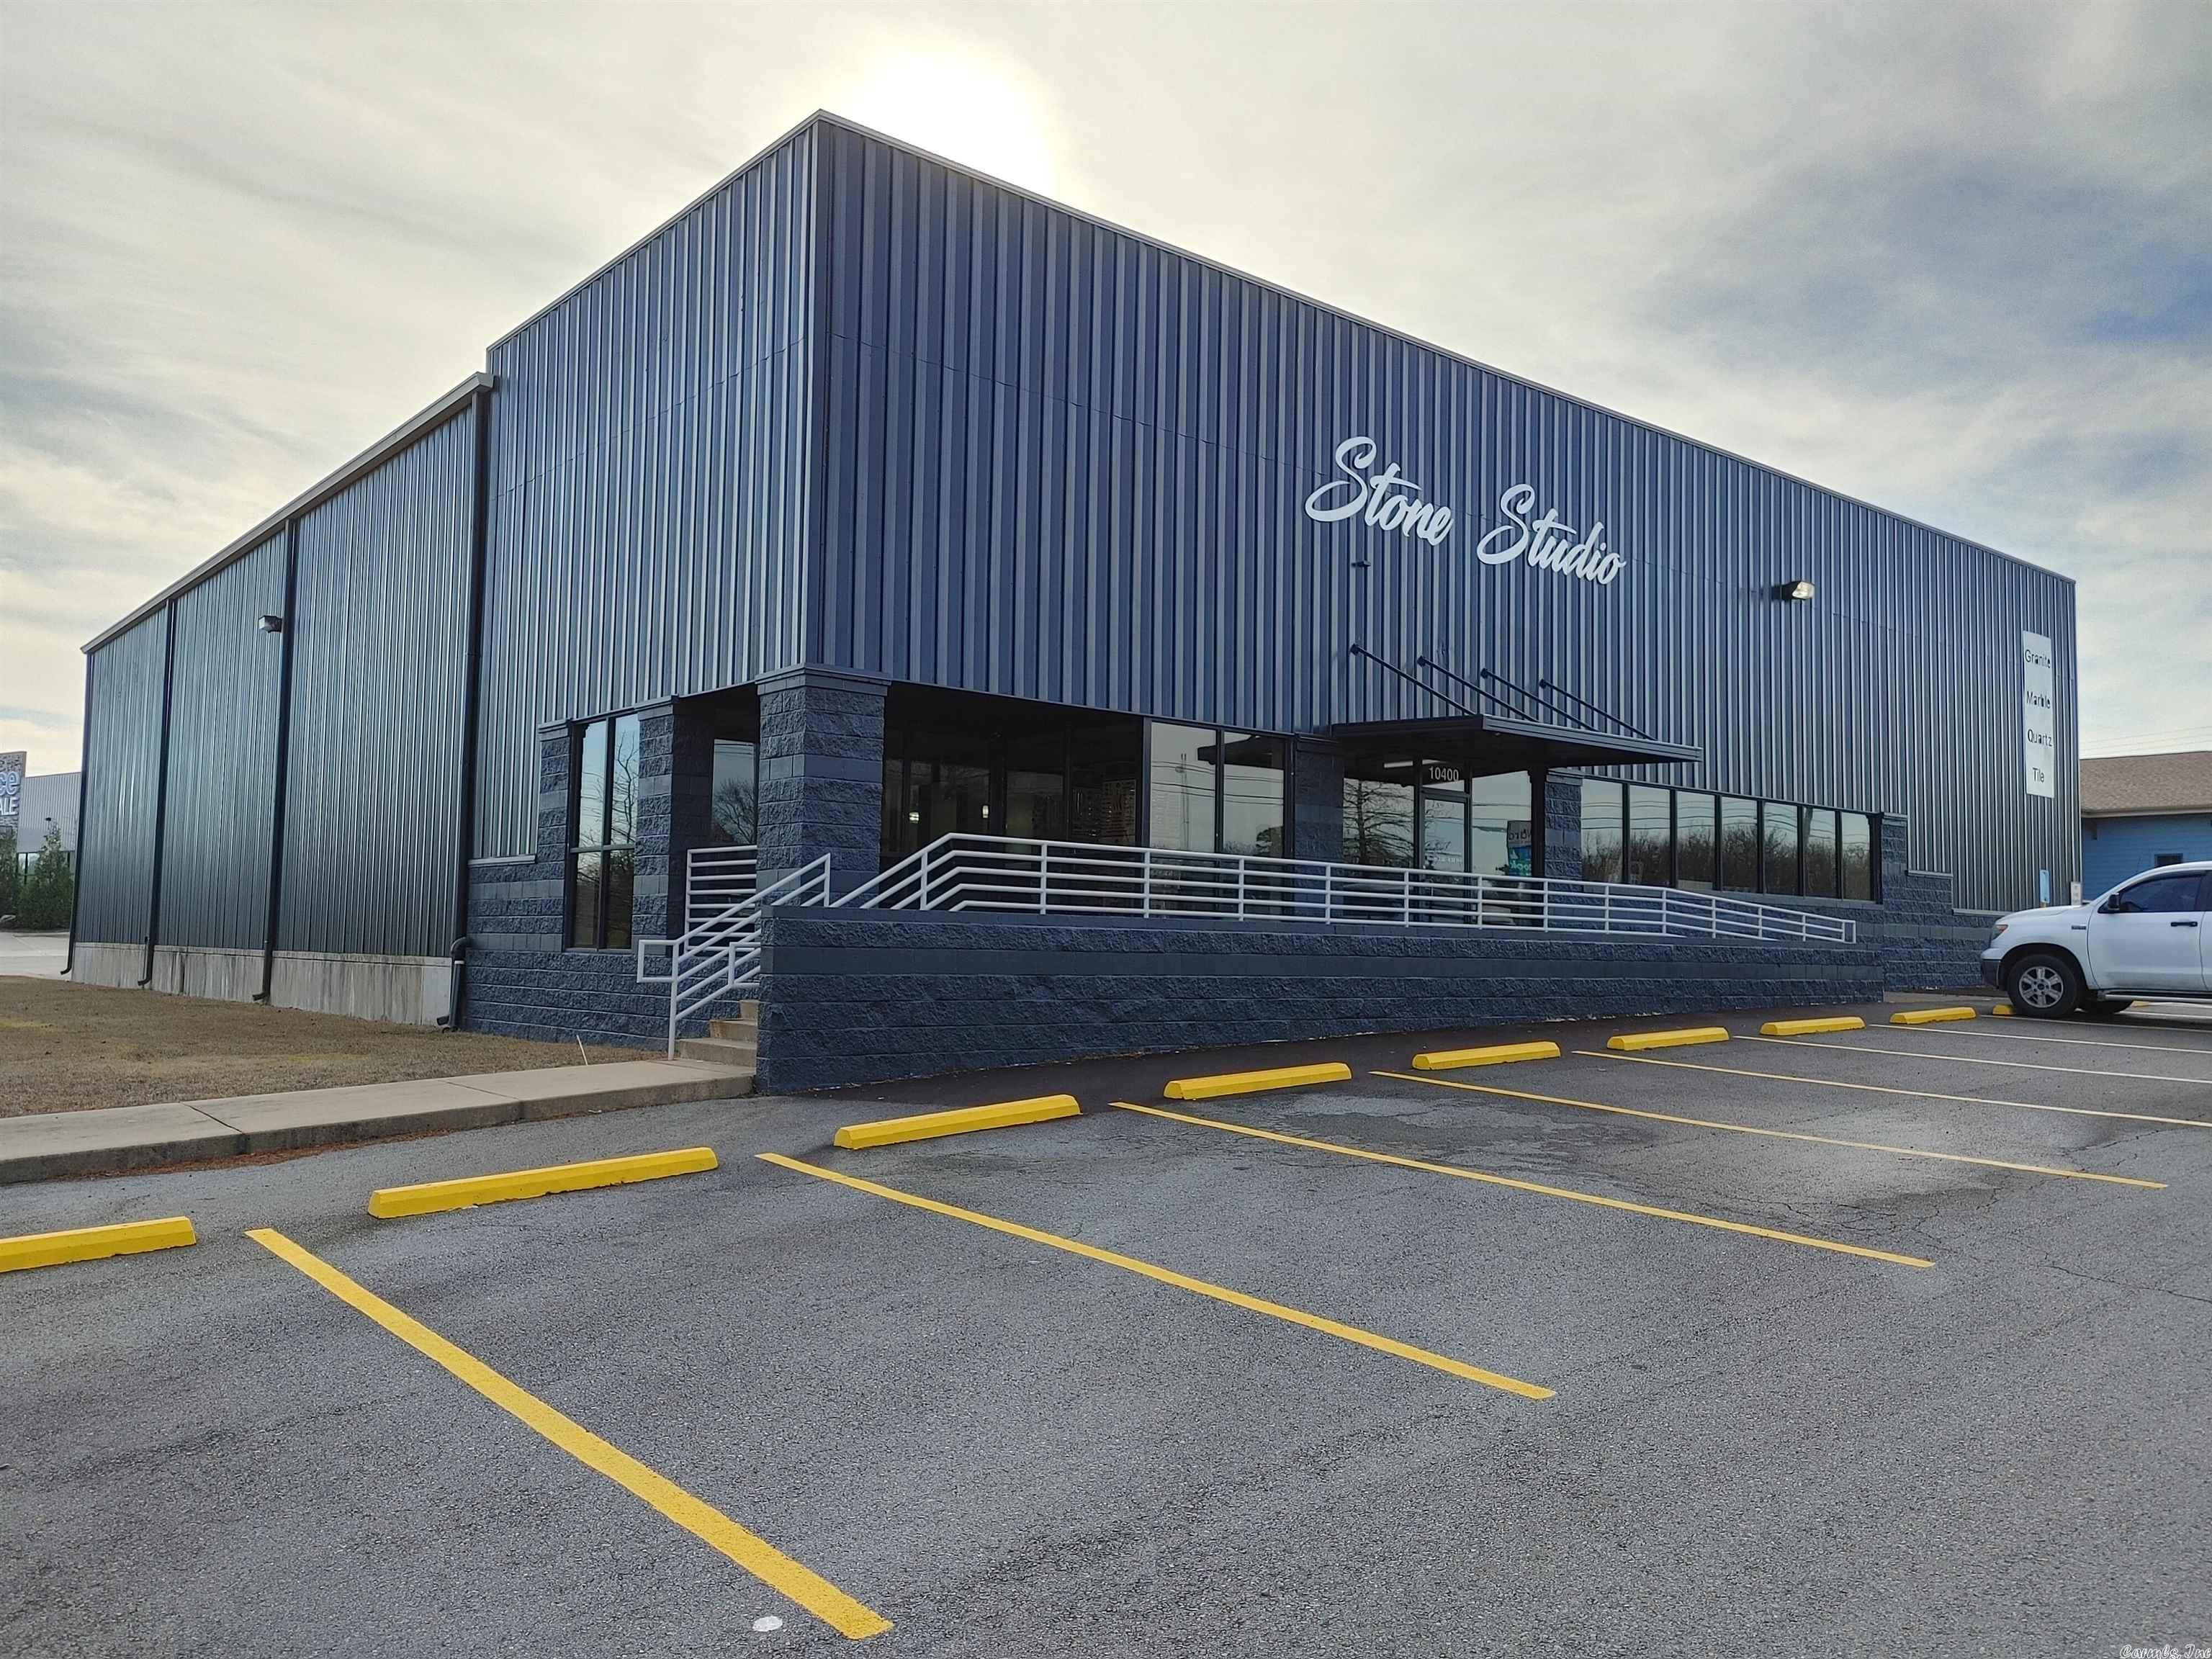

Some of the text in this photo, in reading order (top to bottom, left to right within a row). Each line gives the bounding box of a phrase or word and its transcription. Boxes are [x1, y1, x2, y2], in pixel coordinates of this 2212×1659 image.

[1305, 436, 1627, 585] Stone Studio
[2025, 649, 2051, 669] Granite
[2026, 691, 2051, 709] Marble
[2028, 729, 2053, 747] Quartz
[1429, 765, 1460, 782] 10400
[2032, 767, 2045, 783] Tile
